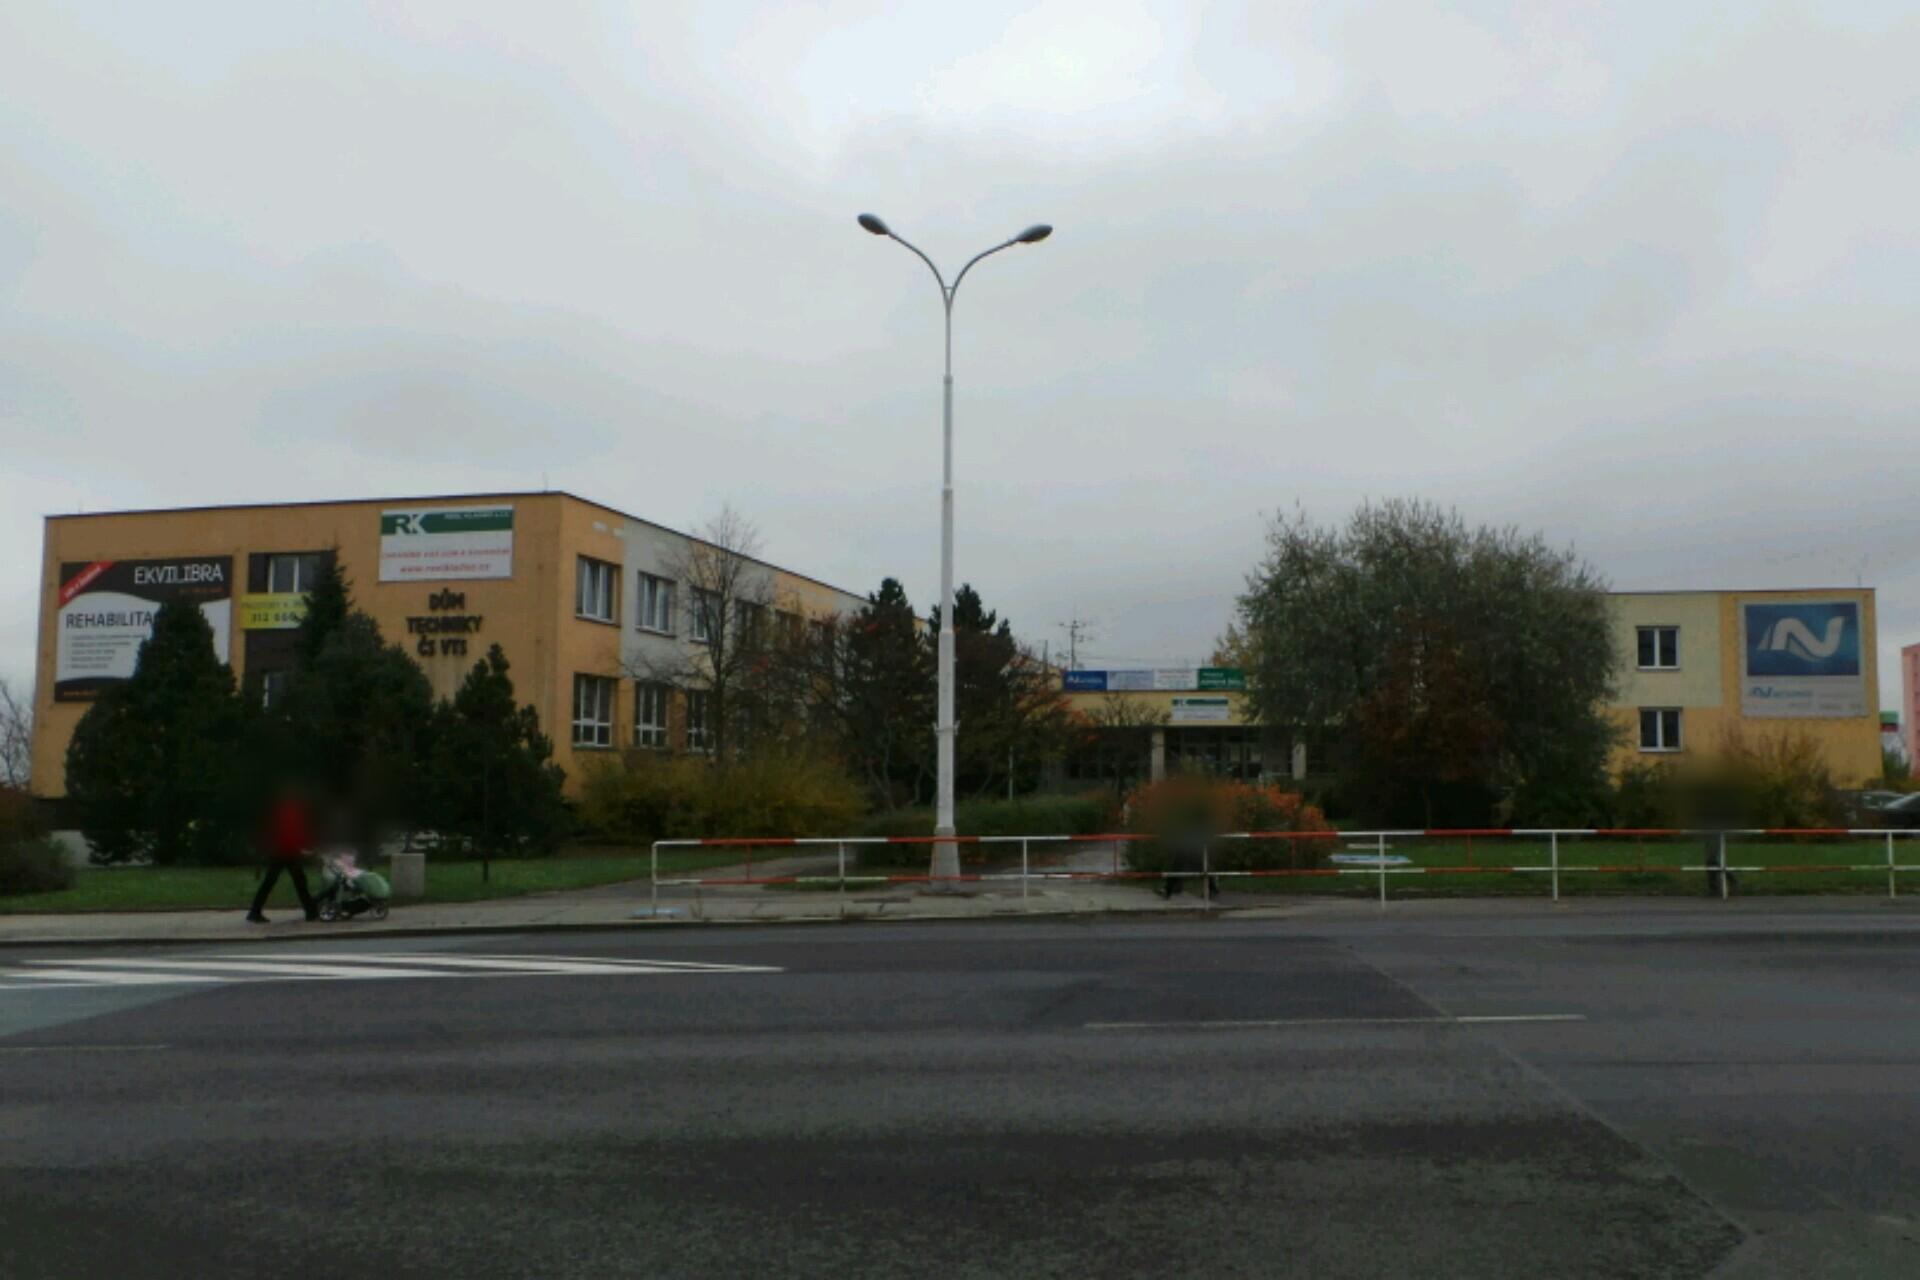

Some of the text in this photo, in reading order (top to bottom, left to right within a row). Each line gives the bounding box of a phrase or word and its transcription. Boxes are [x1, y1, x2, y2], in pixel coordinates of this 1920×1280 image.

[395, 513, 428, 535] RK
[134, 564, 223, 584] EKVILIBRA
[66, 611, 156, 629] REHABILITA
[406, 616, 482, 634] TECHNIKY
